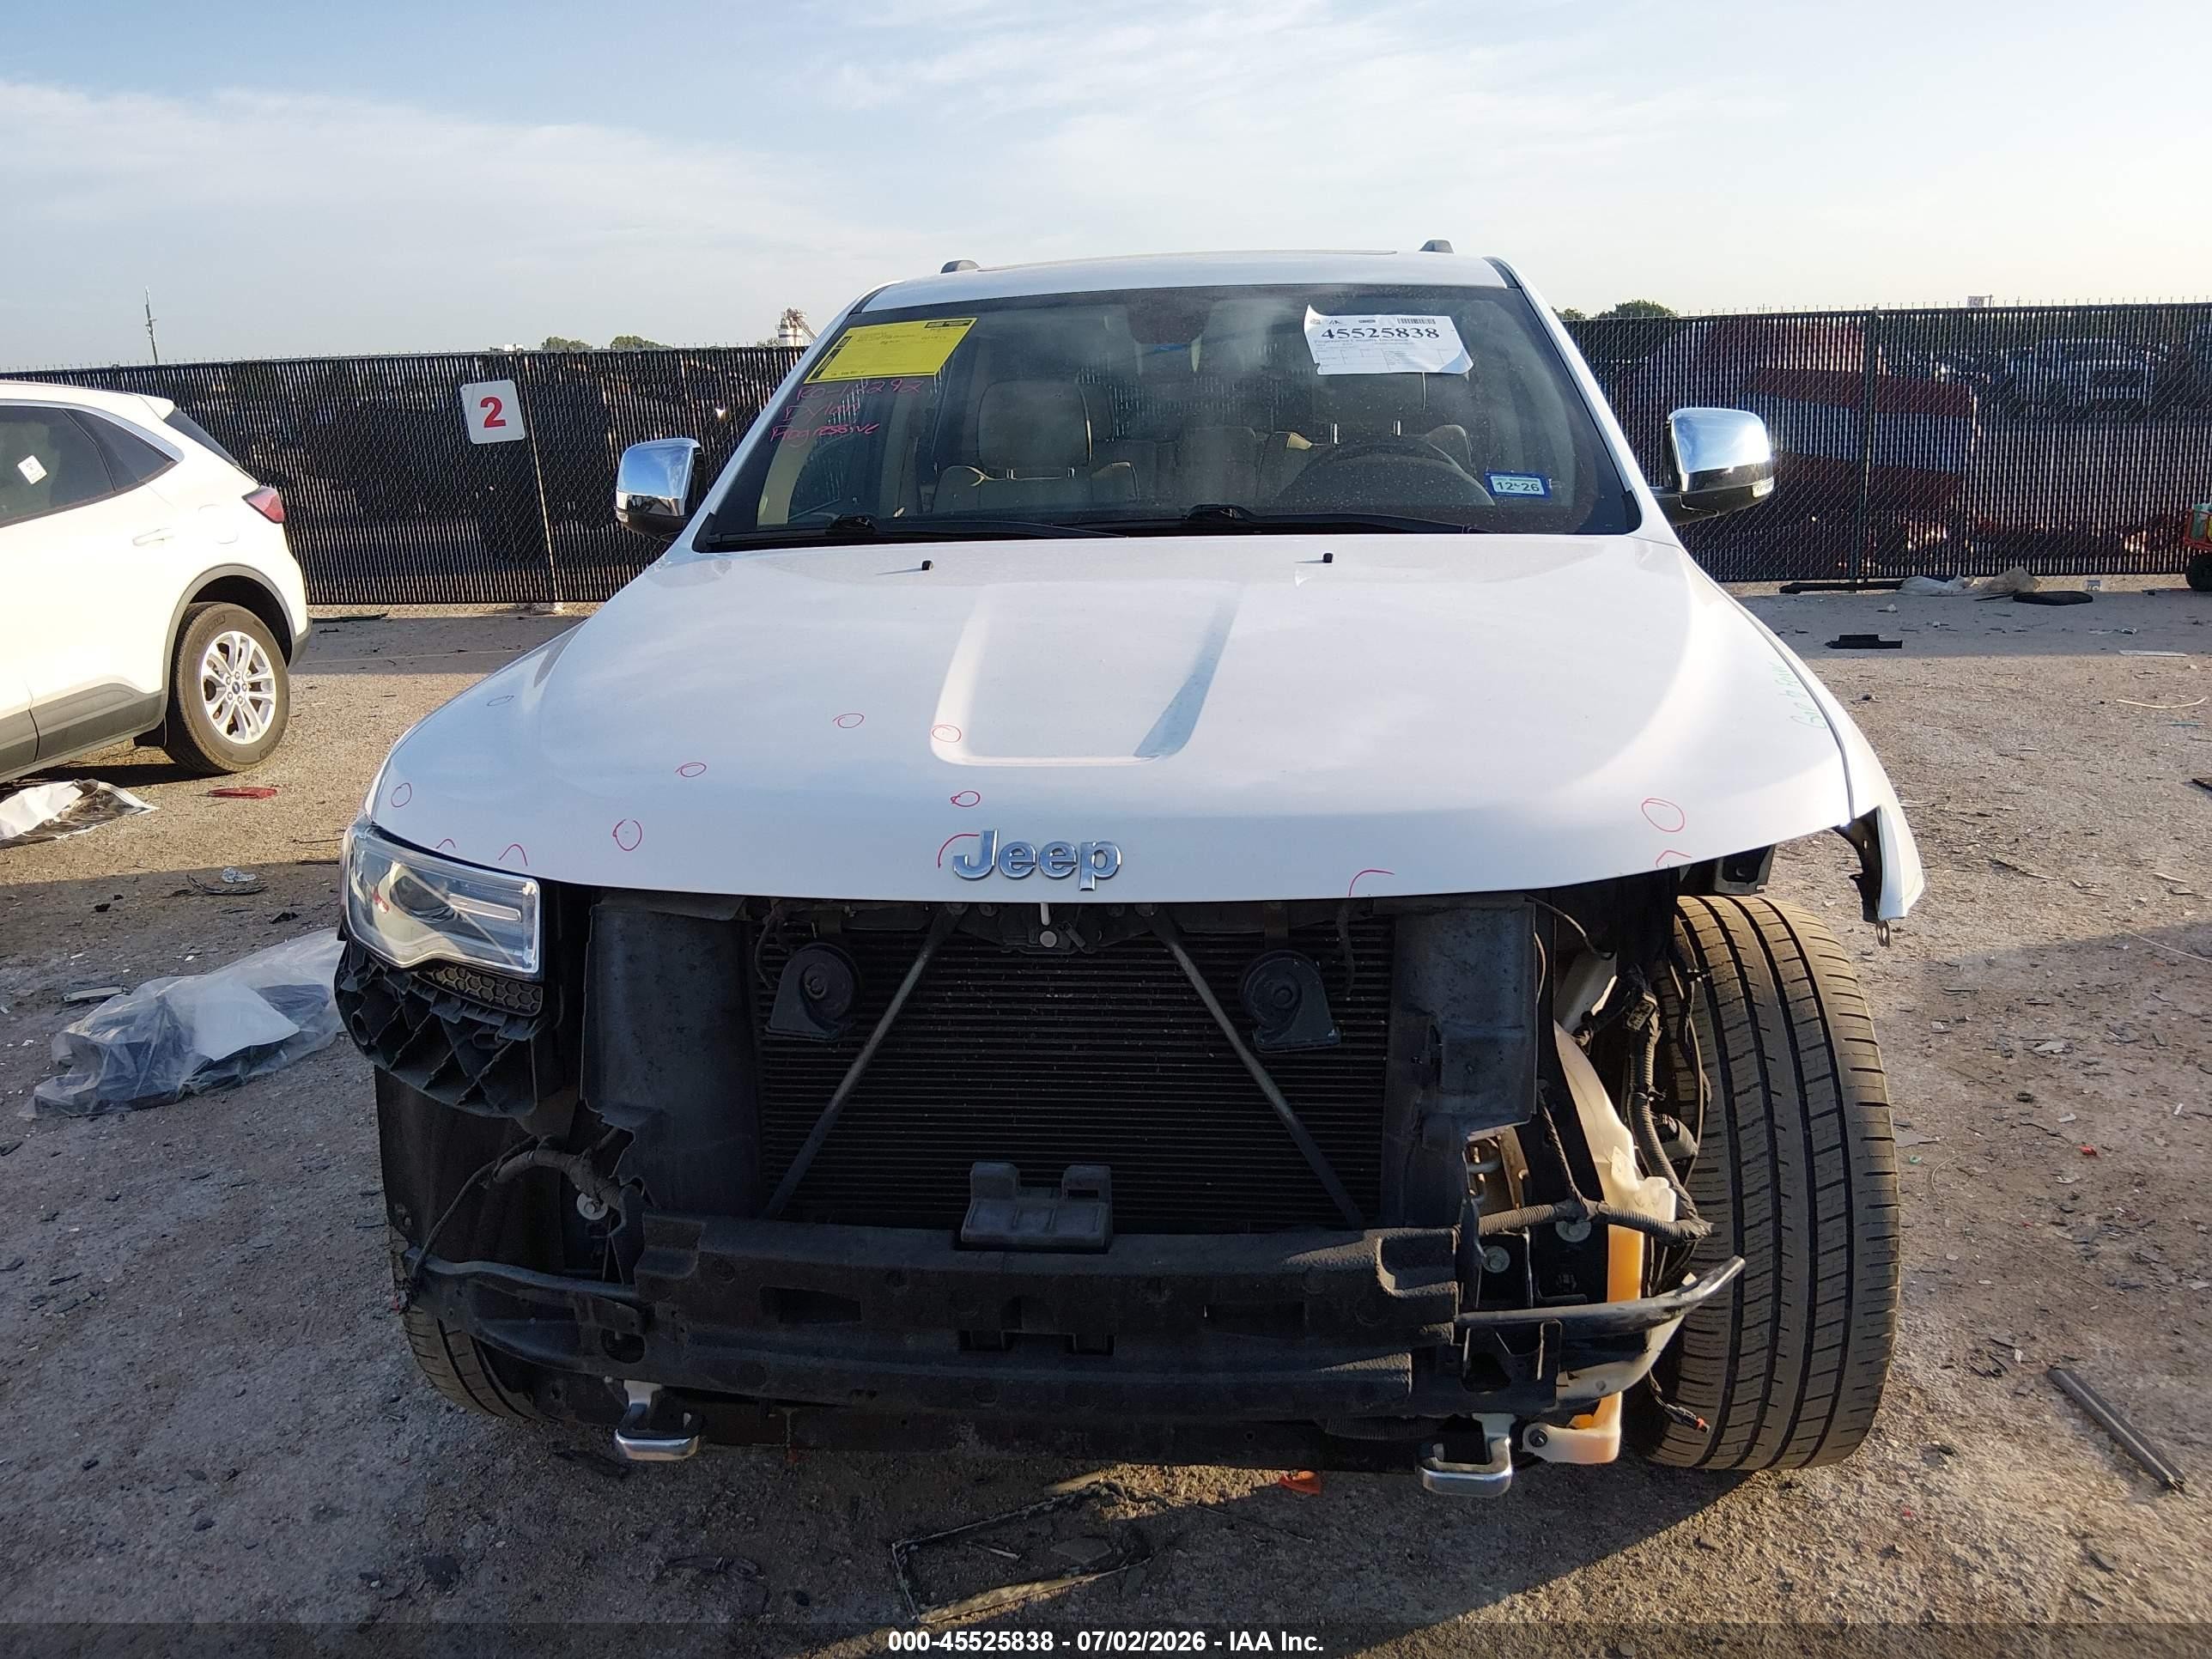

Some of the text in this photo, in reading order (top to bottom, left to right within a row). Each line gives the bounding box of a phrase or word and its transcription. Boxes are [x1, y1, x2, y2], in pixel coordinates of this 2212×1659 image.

[1321, 327, 1440, 339] 45525838
[480, 396, 507, 428] 2
[953, 829, 1121, 891] Jeep
